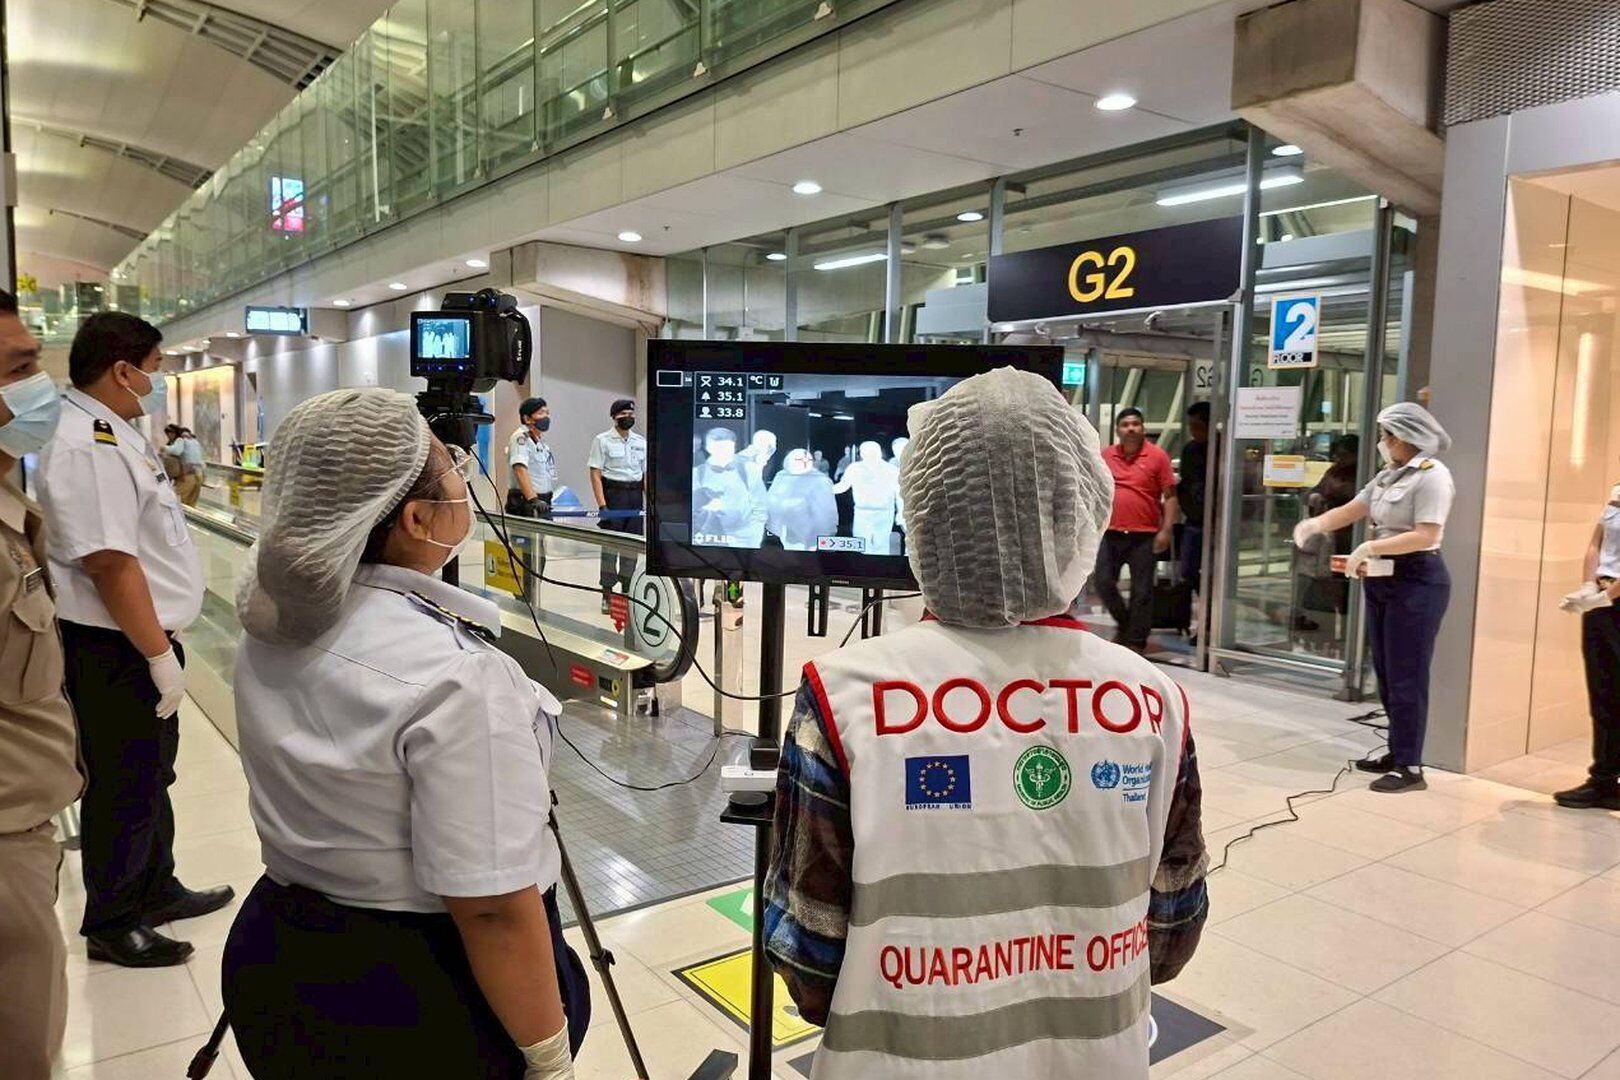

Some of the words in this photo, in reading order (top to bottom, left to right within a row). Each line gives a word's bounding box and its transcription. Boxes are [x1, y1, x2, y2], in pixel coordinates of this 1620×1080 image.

[1068, 246, 1136, 303] G2
[1284, 301, 1316, 352] 2
[717, 376, 743, 387] 34.1
[717, 391, 743, 401] 35.1
[717, 407, 744, 417] 33.8
[643, 581, 660, 638] 2
[872, 677, 1163, 736] DOCTOR
[1122, 763, 1143, 775] World
[880, 934, 1075, 989] QUARANTINE
